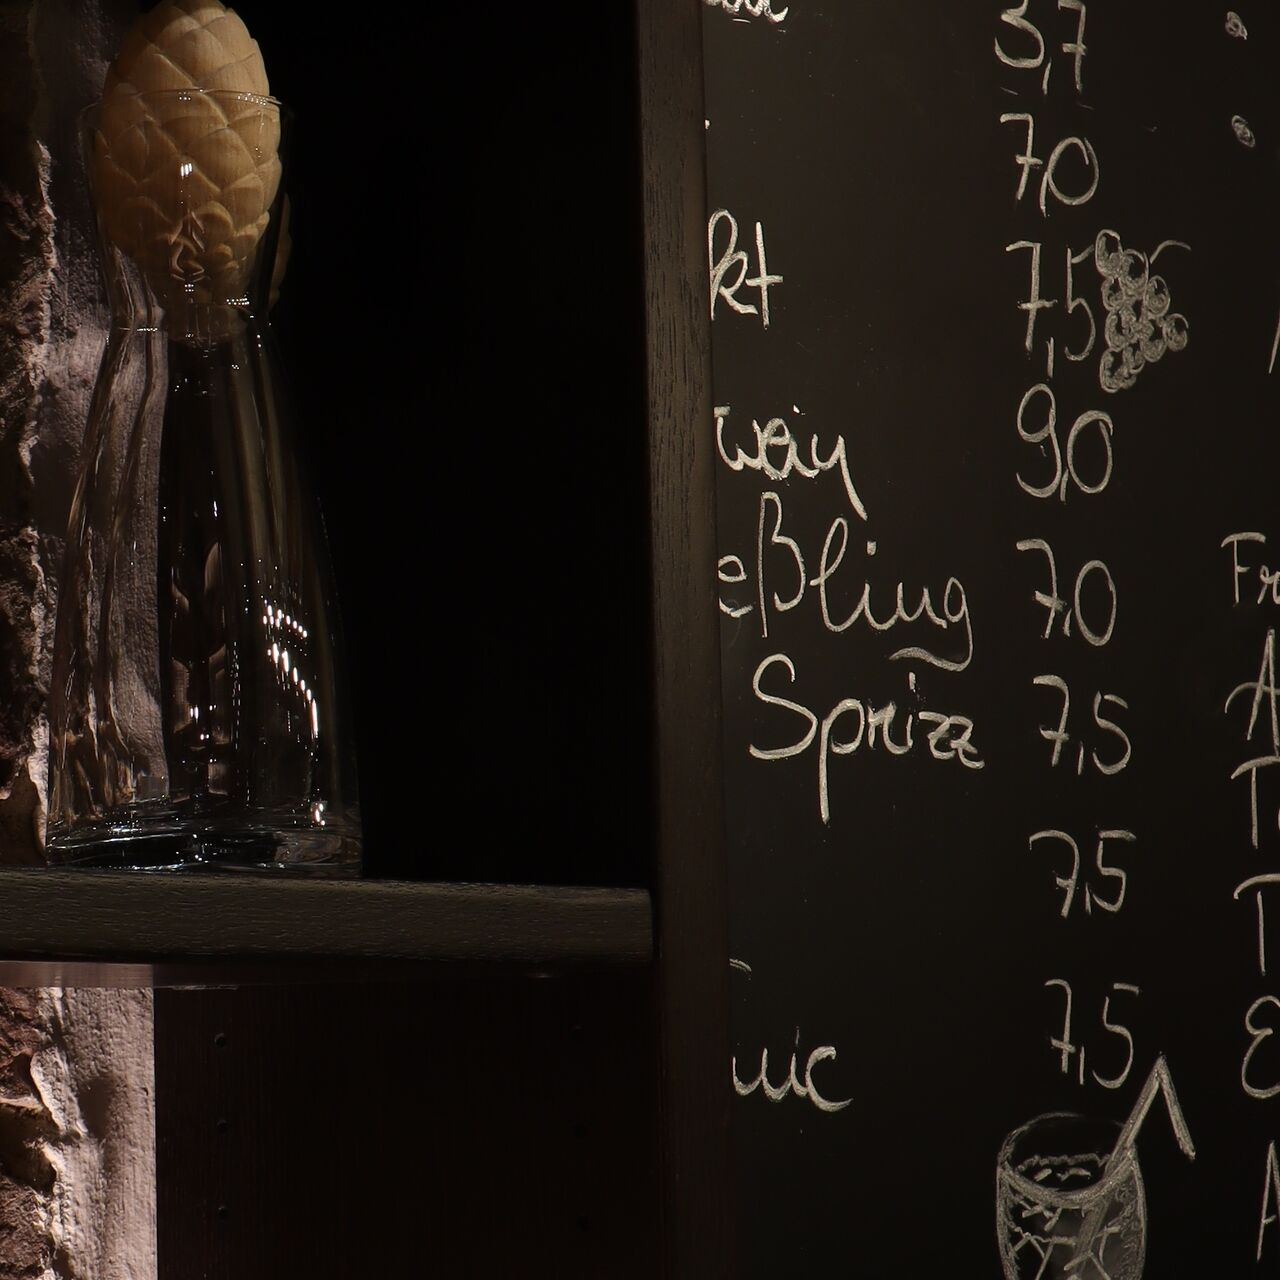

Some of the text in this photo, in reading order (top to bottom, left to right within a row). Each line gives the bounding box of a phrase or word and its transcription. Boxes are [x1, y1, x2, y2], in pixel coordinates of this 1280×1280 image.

[999, 112, 1101, 218] 7,0
[1015, 382, 1115, 503] 9,0
[1015, 537, 1119, 648] 7,0
[1031, 672, 1132, 777] 7,5
[1028, 827, 1138, 920] 7,5
[1043, 977, 1141, 1091] 7,5
